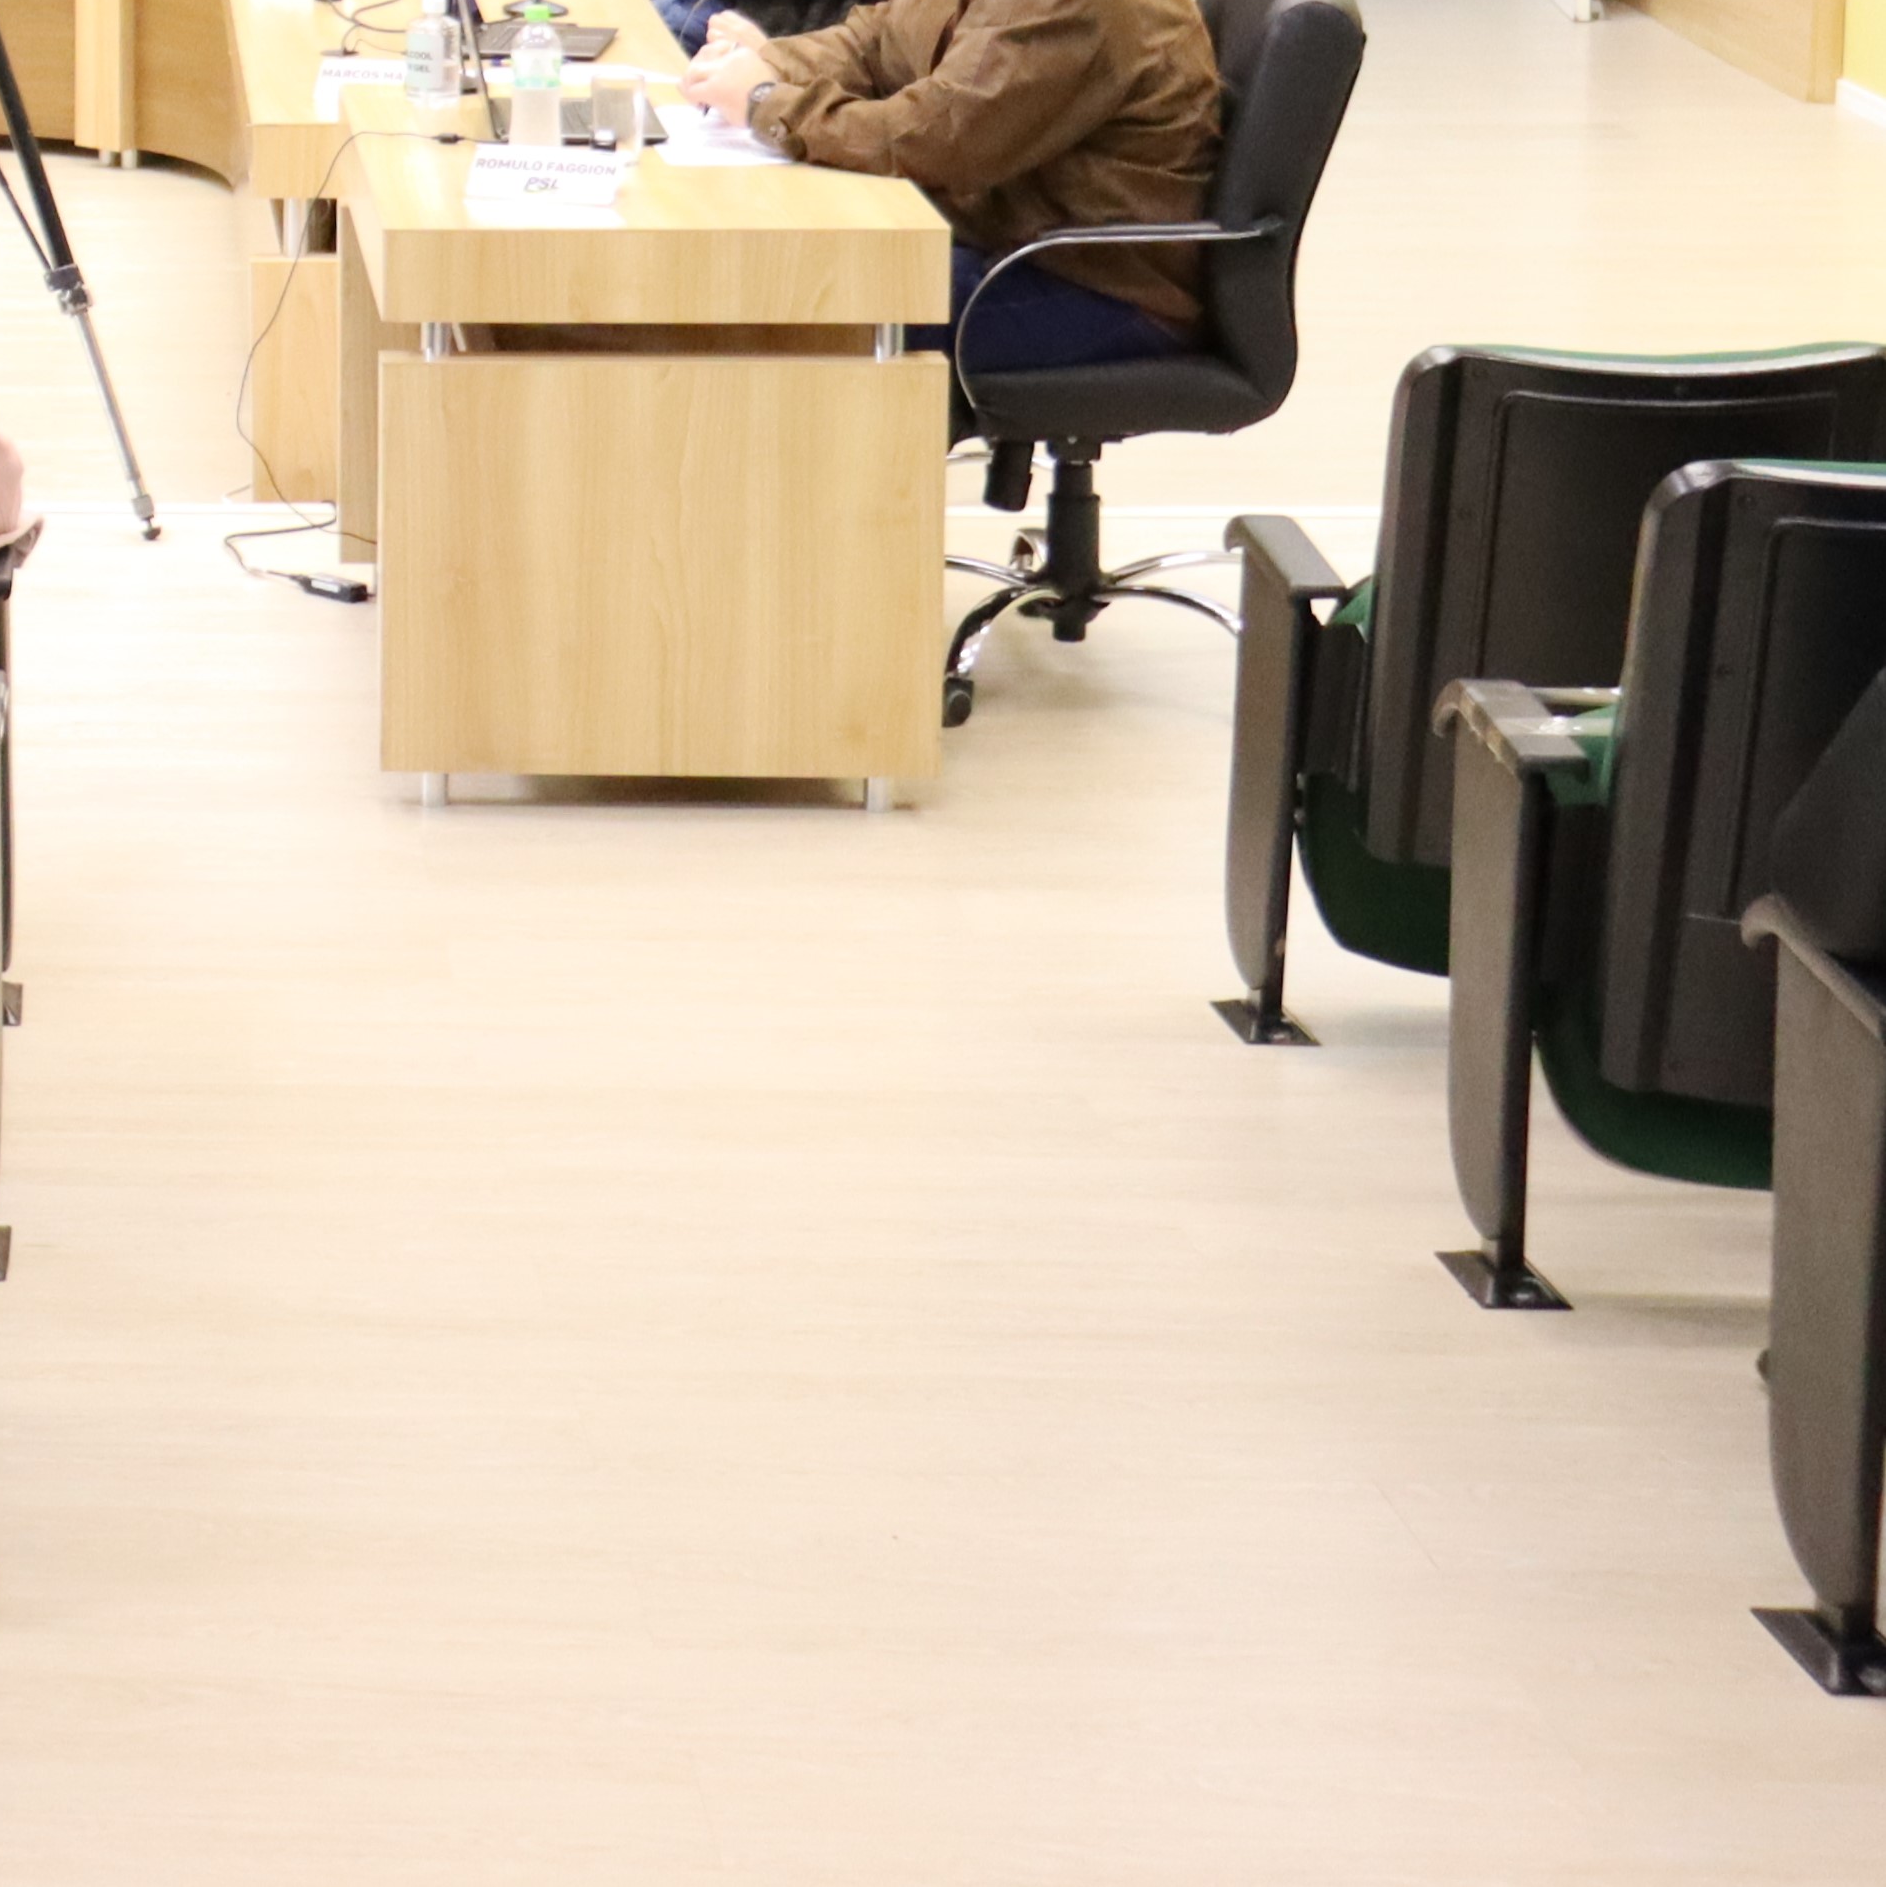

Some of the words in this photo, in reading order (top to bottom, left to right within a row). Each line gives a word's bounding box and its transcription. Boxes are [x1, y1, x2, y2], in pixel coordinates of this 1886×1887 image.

[321, 68, 380, 80] MARCOS
[383, 71, 404, 81] MA
[475, 158, 543, 171] ROMULO
[546, 161, 617, 176] FAGGION
